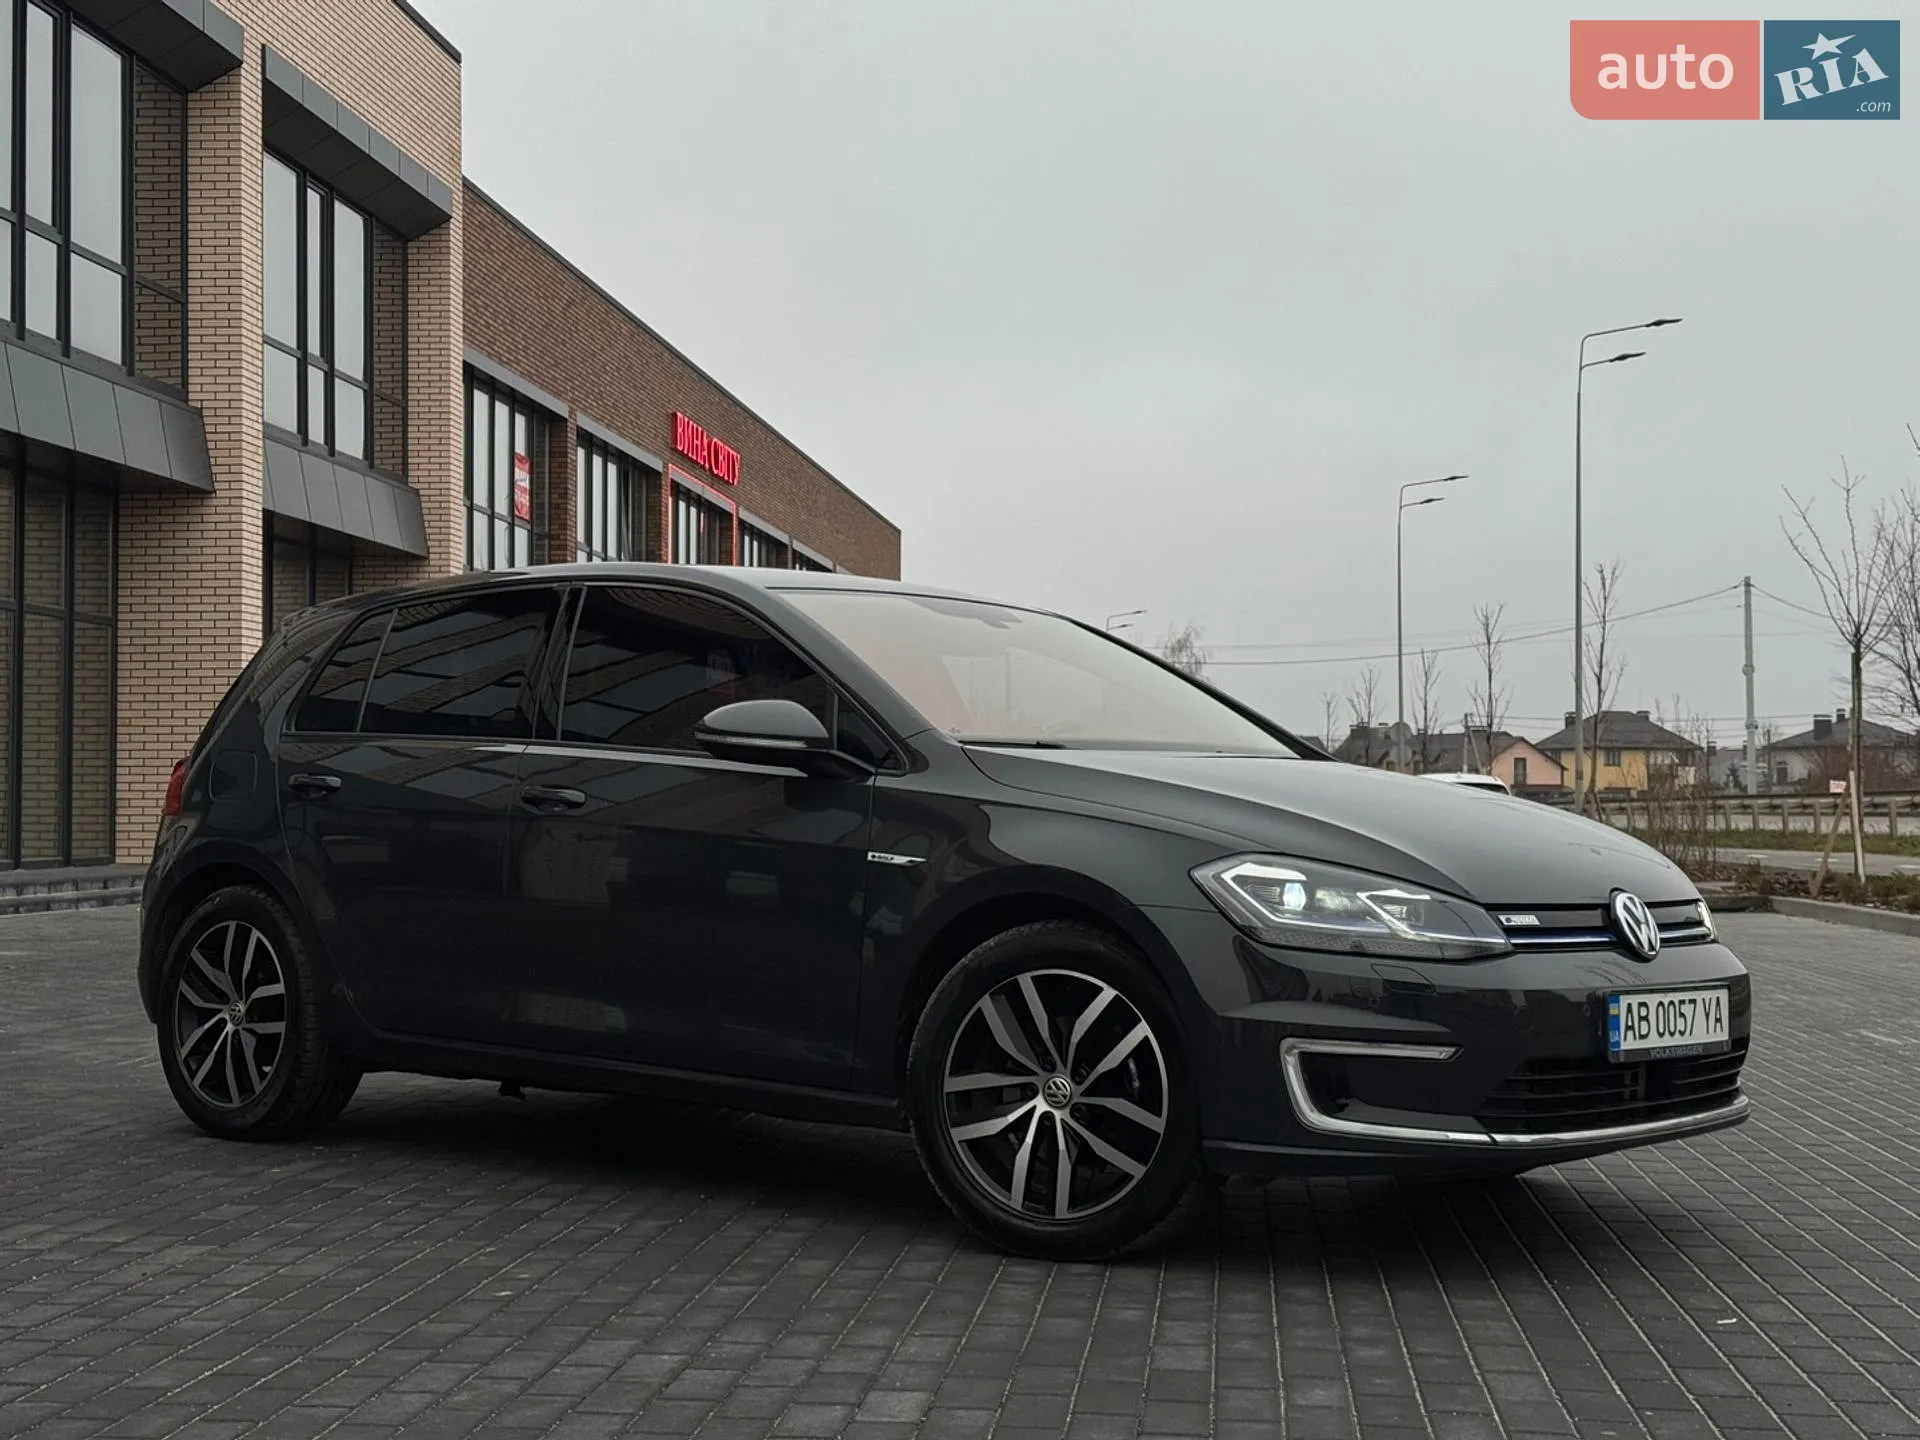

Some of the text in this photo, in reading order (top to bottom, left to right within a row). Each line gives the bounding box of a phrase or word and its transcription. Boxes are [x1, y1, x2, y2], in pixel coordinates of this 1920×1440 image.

[676, 411, 741, 486] ВИНА СВІТУ
[1623, 995, 1724, 1042] AB 0057 YA
